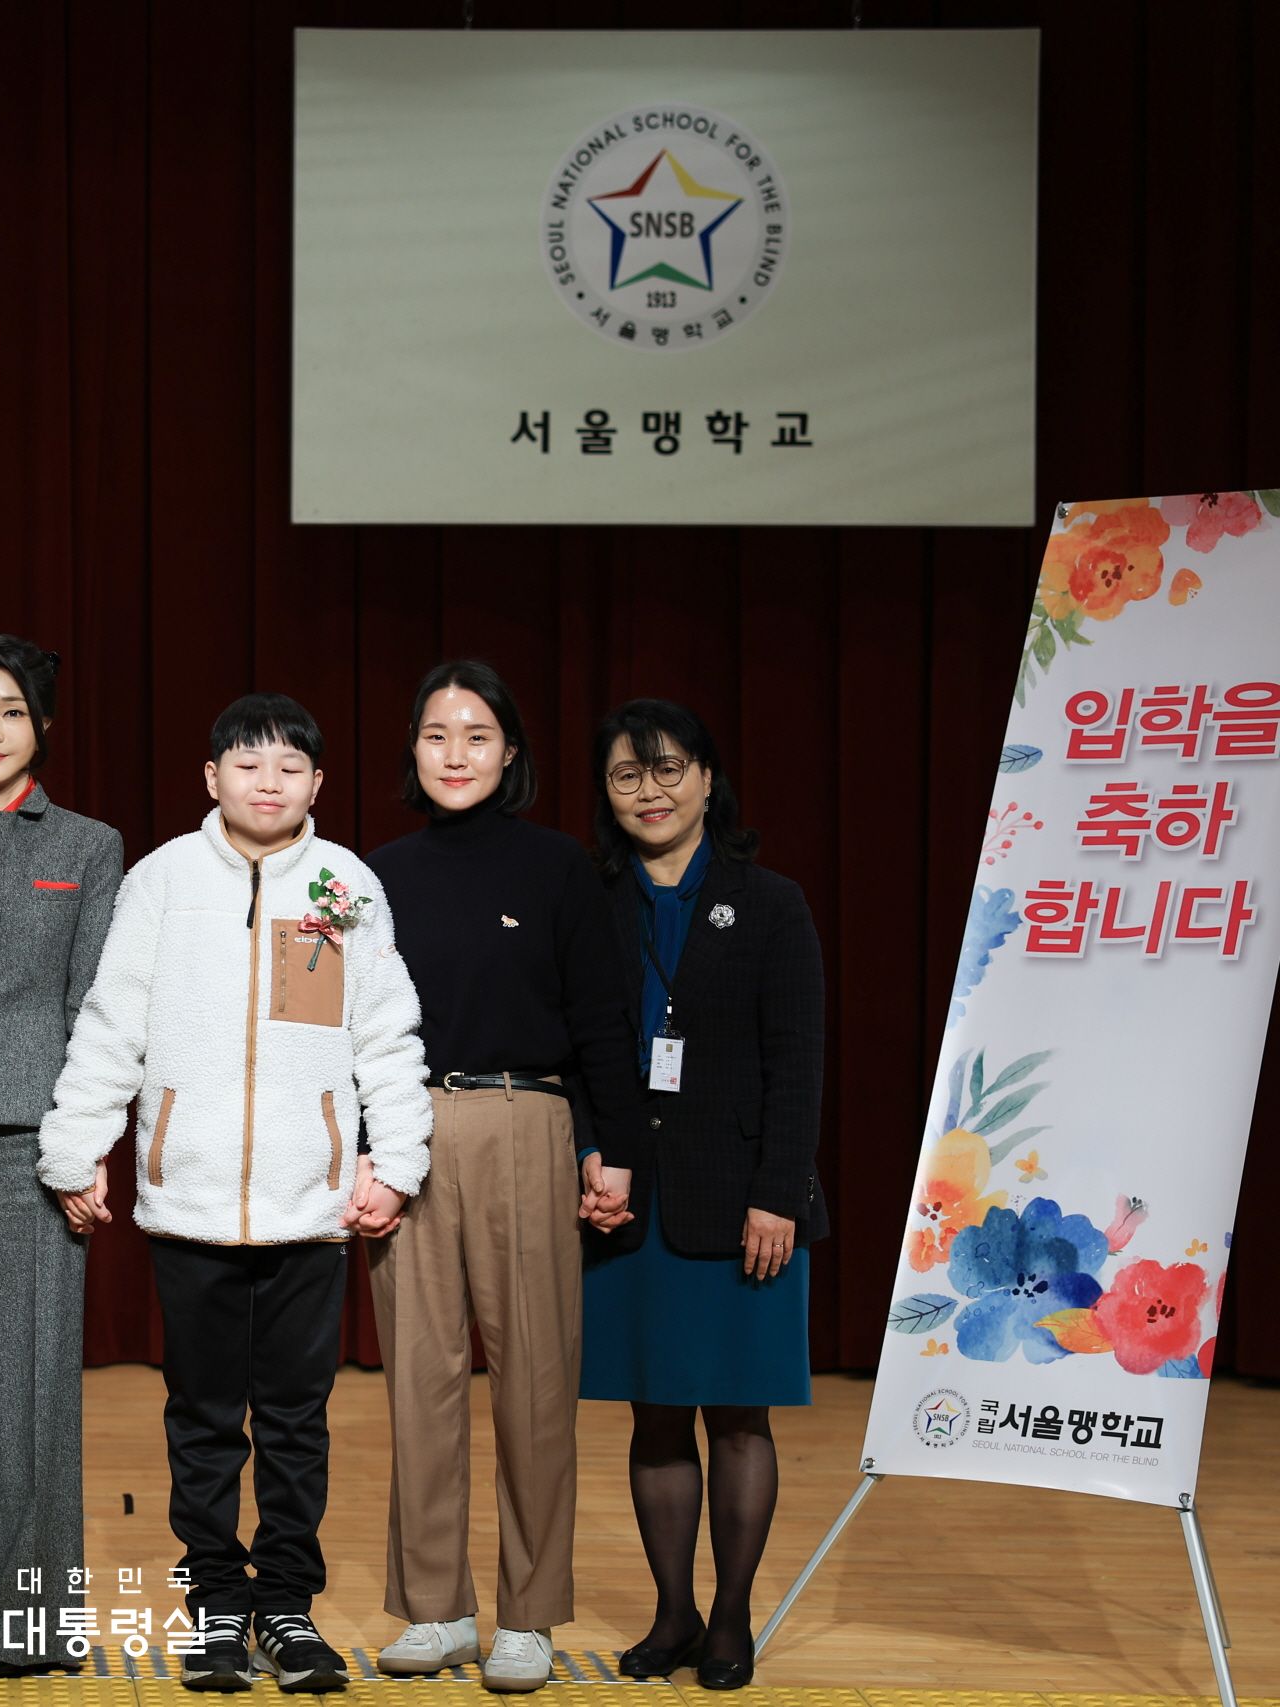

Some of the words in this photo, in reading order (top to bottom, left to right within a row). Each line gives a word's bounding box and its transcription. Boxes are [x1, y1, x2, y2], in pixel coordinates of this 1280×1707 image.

[632, 112, 720, 140] SCHOOL
[551, 123, 628, 211] NATIONAL
[724, 132, 762, 172] FOR
[757, 175, 782, 214] THE
[629, 211, 695, 239] SNSB
[547, 219, 576, 287] SEOUL
[753, 223, 783, 288] BLIND
[646, 290, 677, 309] 1913
[511, 409, 814, 455] 서울맹학교
[1064, 681, 1280, 760] 입학을
[1076, 781, 1234, 857] 축하
[1023, 880, 1254, 956] 합니다
[932, 1413, 950, 1423] SNSB
[977, 1399, 999, 1435] 국립
[998, 1403, 1164, 1449] 서울맹학교
[972, 1439, 1001, 1451] SEOUL
[1003, 1442, 1047, 1456] NATIONAL
[1049, 1447, 1087, 1460] SCHOOL
[1090, 1451, 1110, 1462] FOR
[1112, 1453, 1131, 1464] THE
[1132, 1455, 1159, 1467] BLIND
